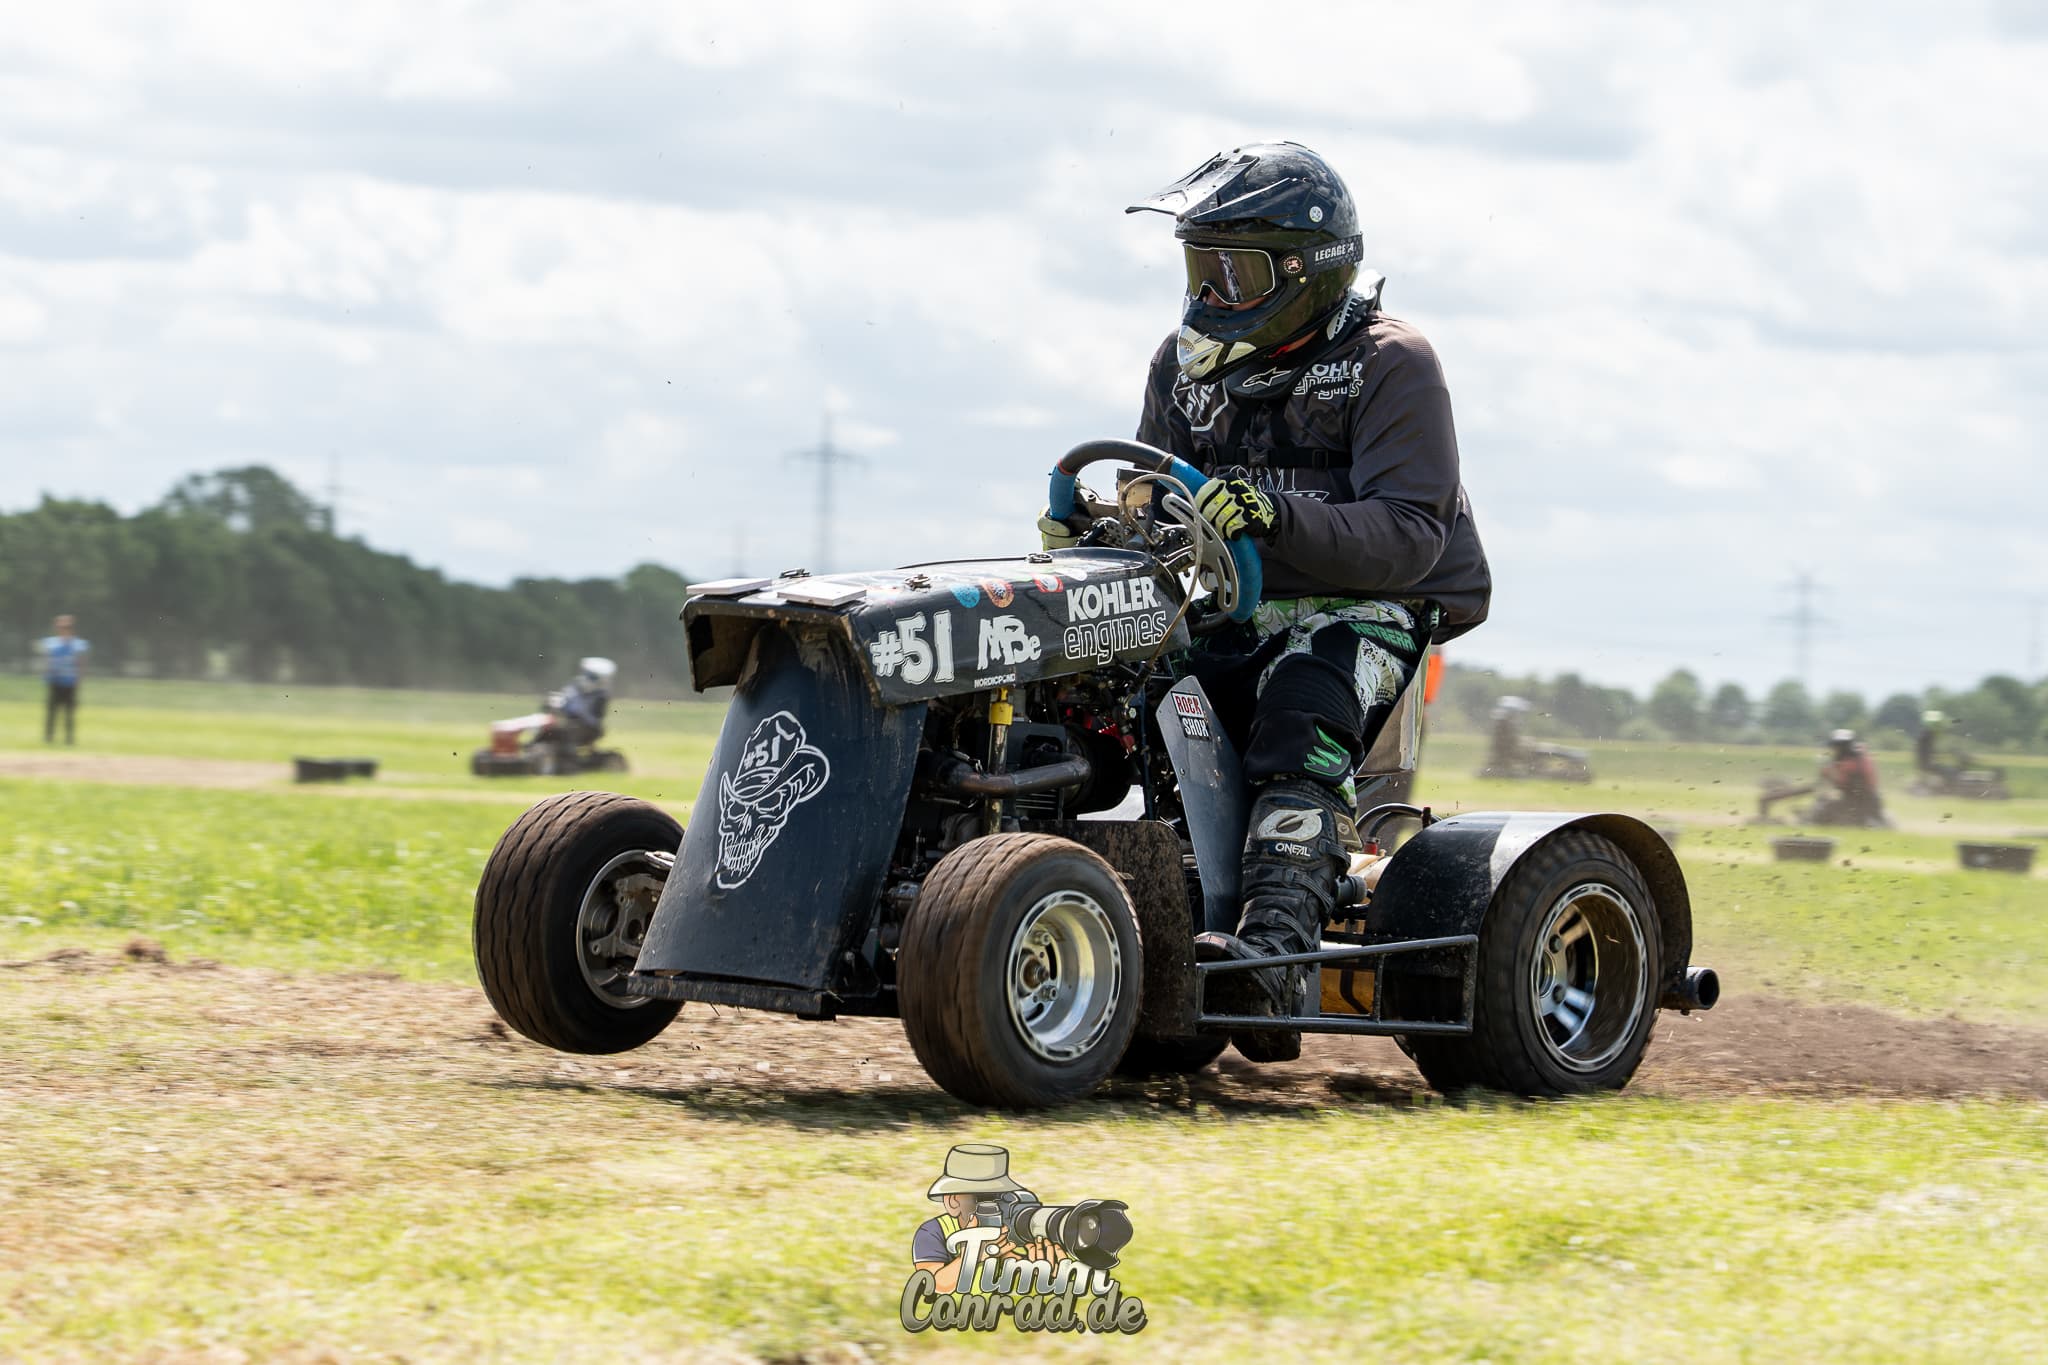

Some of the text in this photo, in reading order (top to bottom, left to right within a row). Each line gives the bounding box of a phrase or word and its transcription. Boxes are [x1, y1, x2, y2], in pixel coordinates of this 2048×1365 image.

[870, 609, 955, 685] #51
[1063, 610, 1167, 666] engines
[1174, 695, 1202, 715] ROCK
[744, 735, 781, 769] #51
